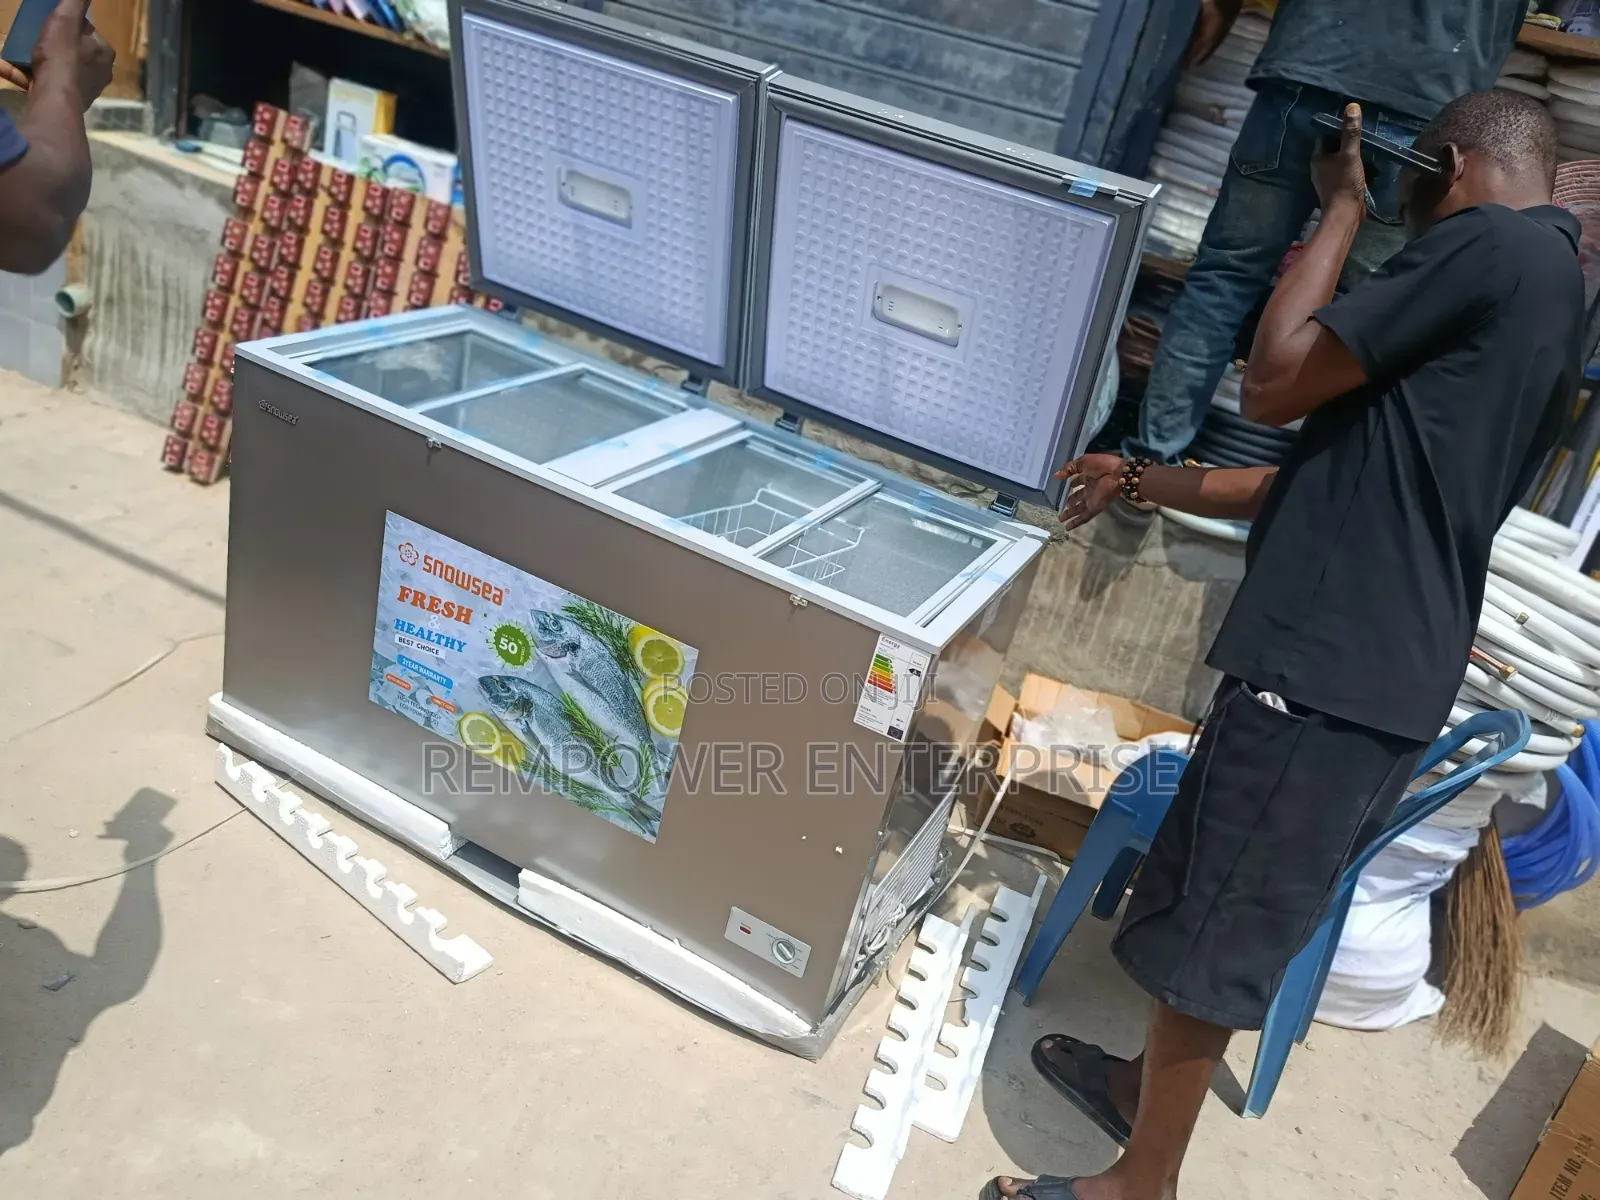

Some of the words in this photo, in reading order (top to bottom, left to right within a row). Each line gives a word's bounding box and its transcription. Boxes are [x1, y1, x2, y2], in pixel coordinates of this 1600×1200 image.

[397, 585, 473, 625] FRESH
[427, 614, 442, 629] &
[394, 618, 467, 653] HEALTHY
[881, 636, 901, 650] Energy
[398, 636, 414, 648] BEST
[416, 643, 440, 656] CHOICE
[499, 637, 518, 655] 50
[419, 666, 447, 685] WARRANTY
[1549, 1173, 1573, 1200] ITEM
